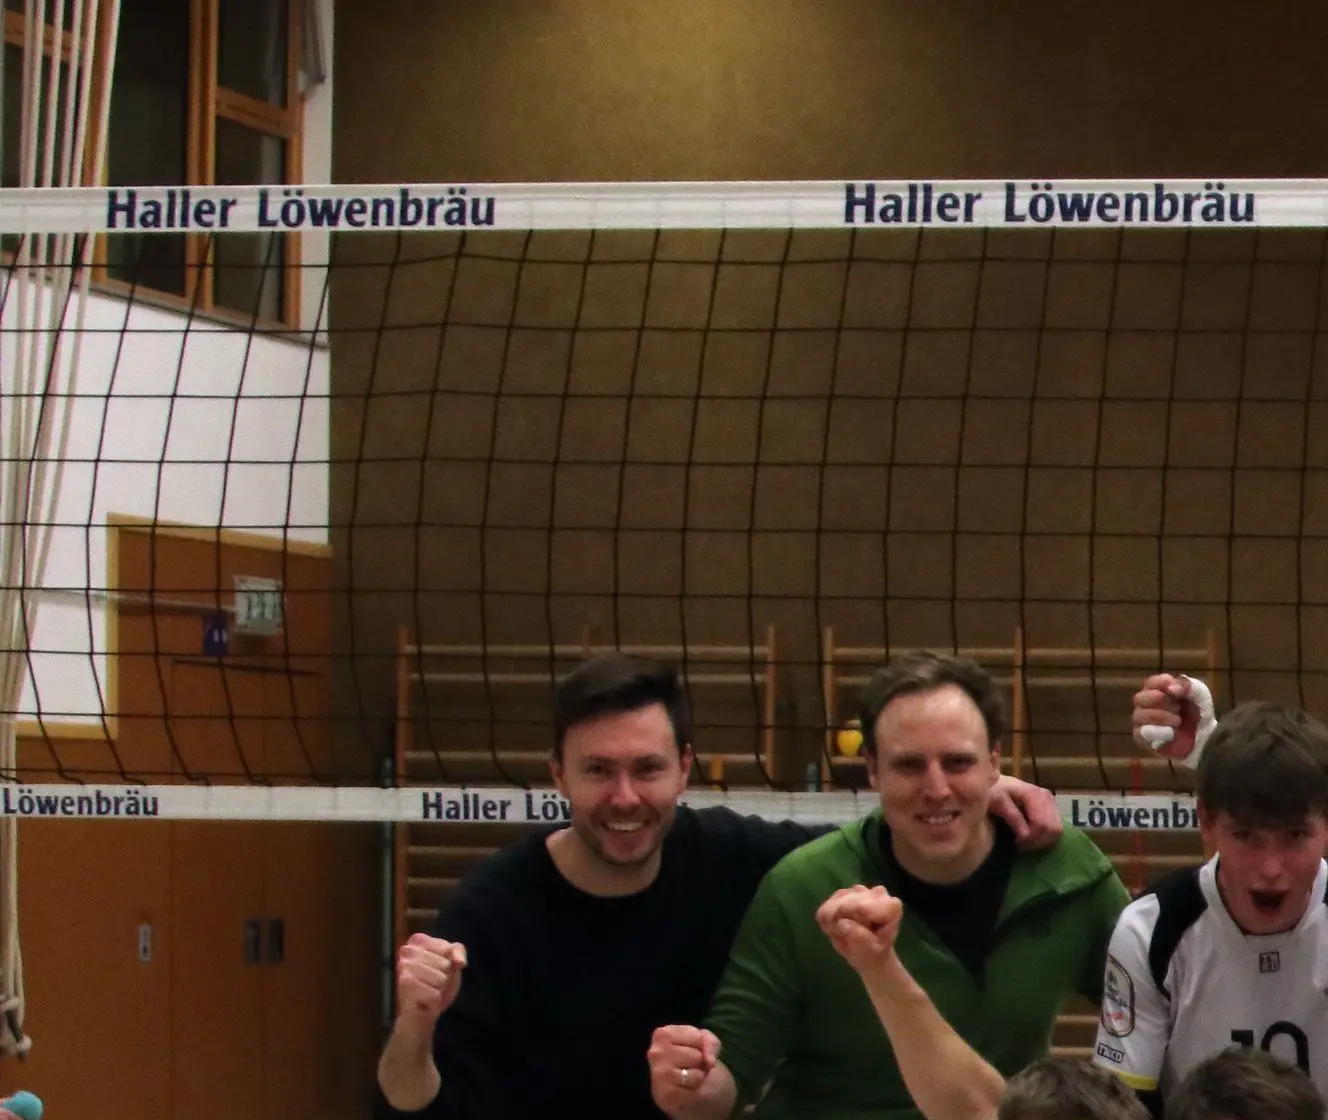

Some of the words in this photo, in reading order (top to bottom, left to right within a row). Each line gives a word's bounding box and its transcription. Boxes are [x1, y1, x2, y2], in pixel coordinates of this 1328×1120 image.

[106, 189, 236, 229] Haller
[258, 188, 495, 228] Löwenbräu
[844, 183, 981, 223] Haller
[1004, 182, 1255, 223] Löwenbräu
[2, 789, 158, 816] Löwenbräu
[423, 791, 510, 820] Haller
